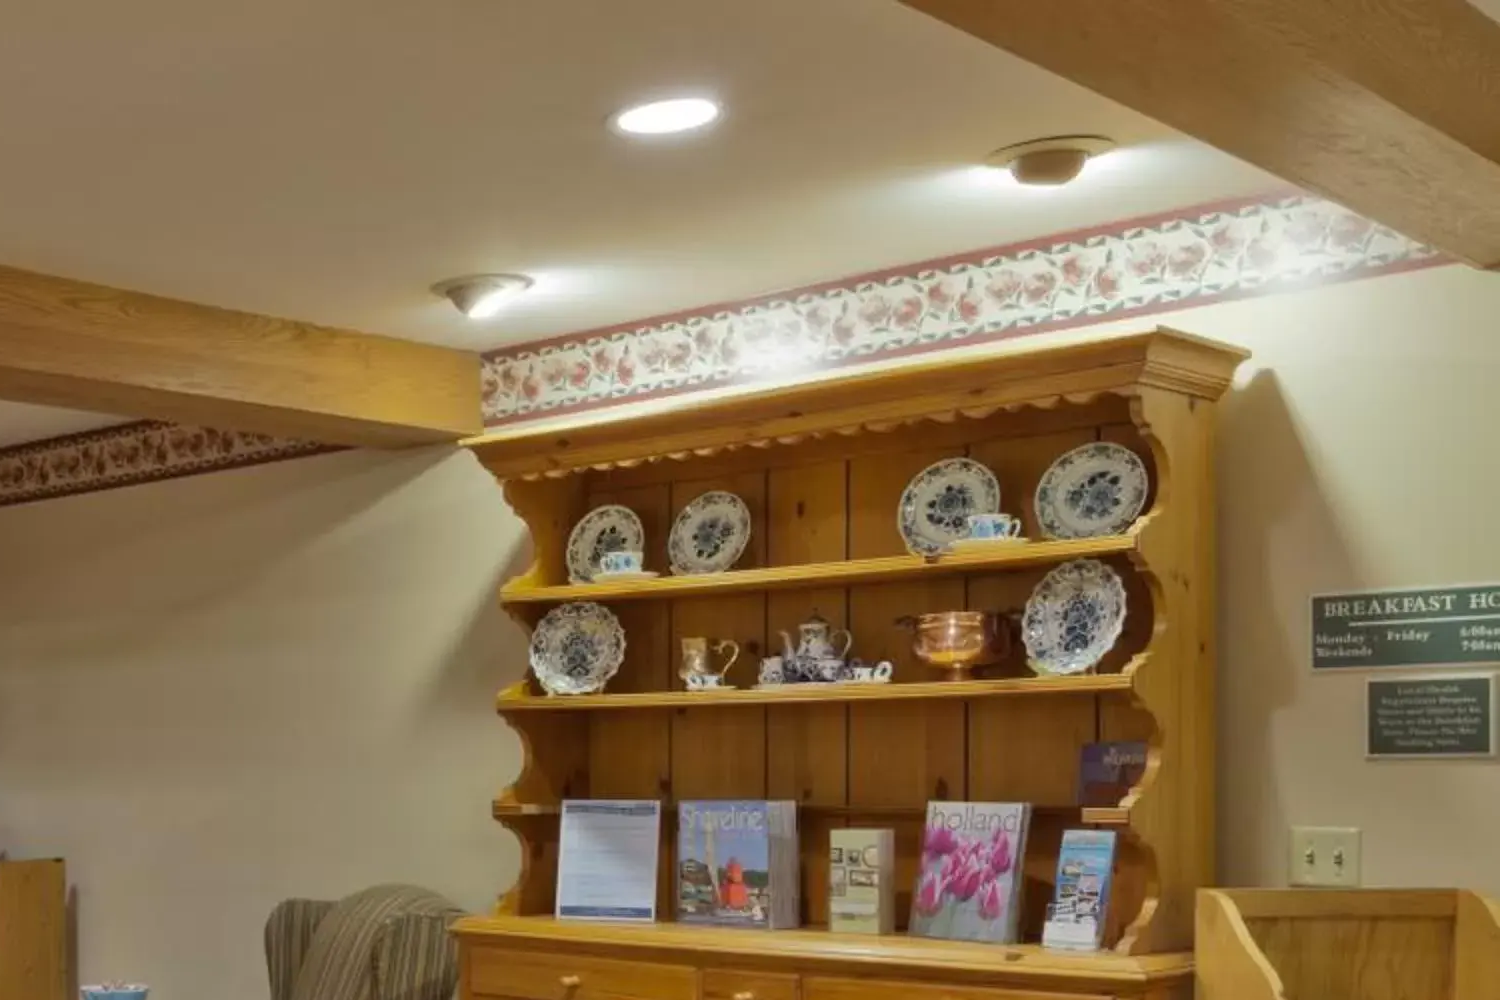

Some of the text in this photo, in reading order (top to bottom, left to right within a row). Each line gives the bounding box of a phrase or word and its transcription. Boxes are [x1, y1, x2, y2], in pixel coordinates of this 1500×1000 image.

[1324, 594, 1457, 617] BREAKFAST
[1386, 629, 1431, 643] Friday
[930, 804, 1020, 833] holland
